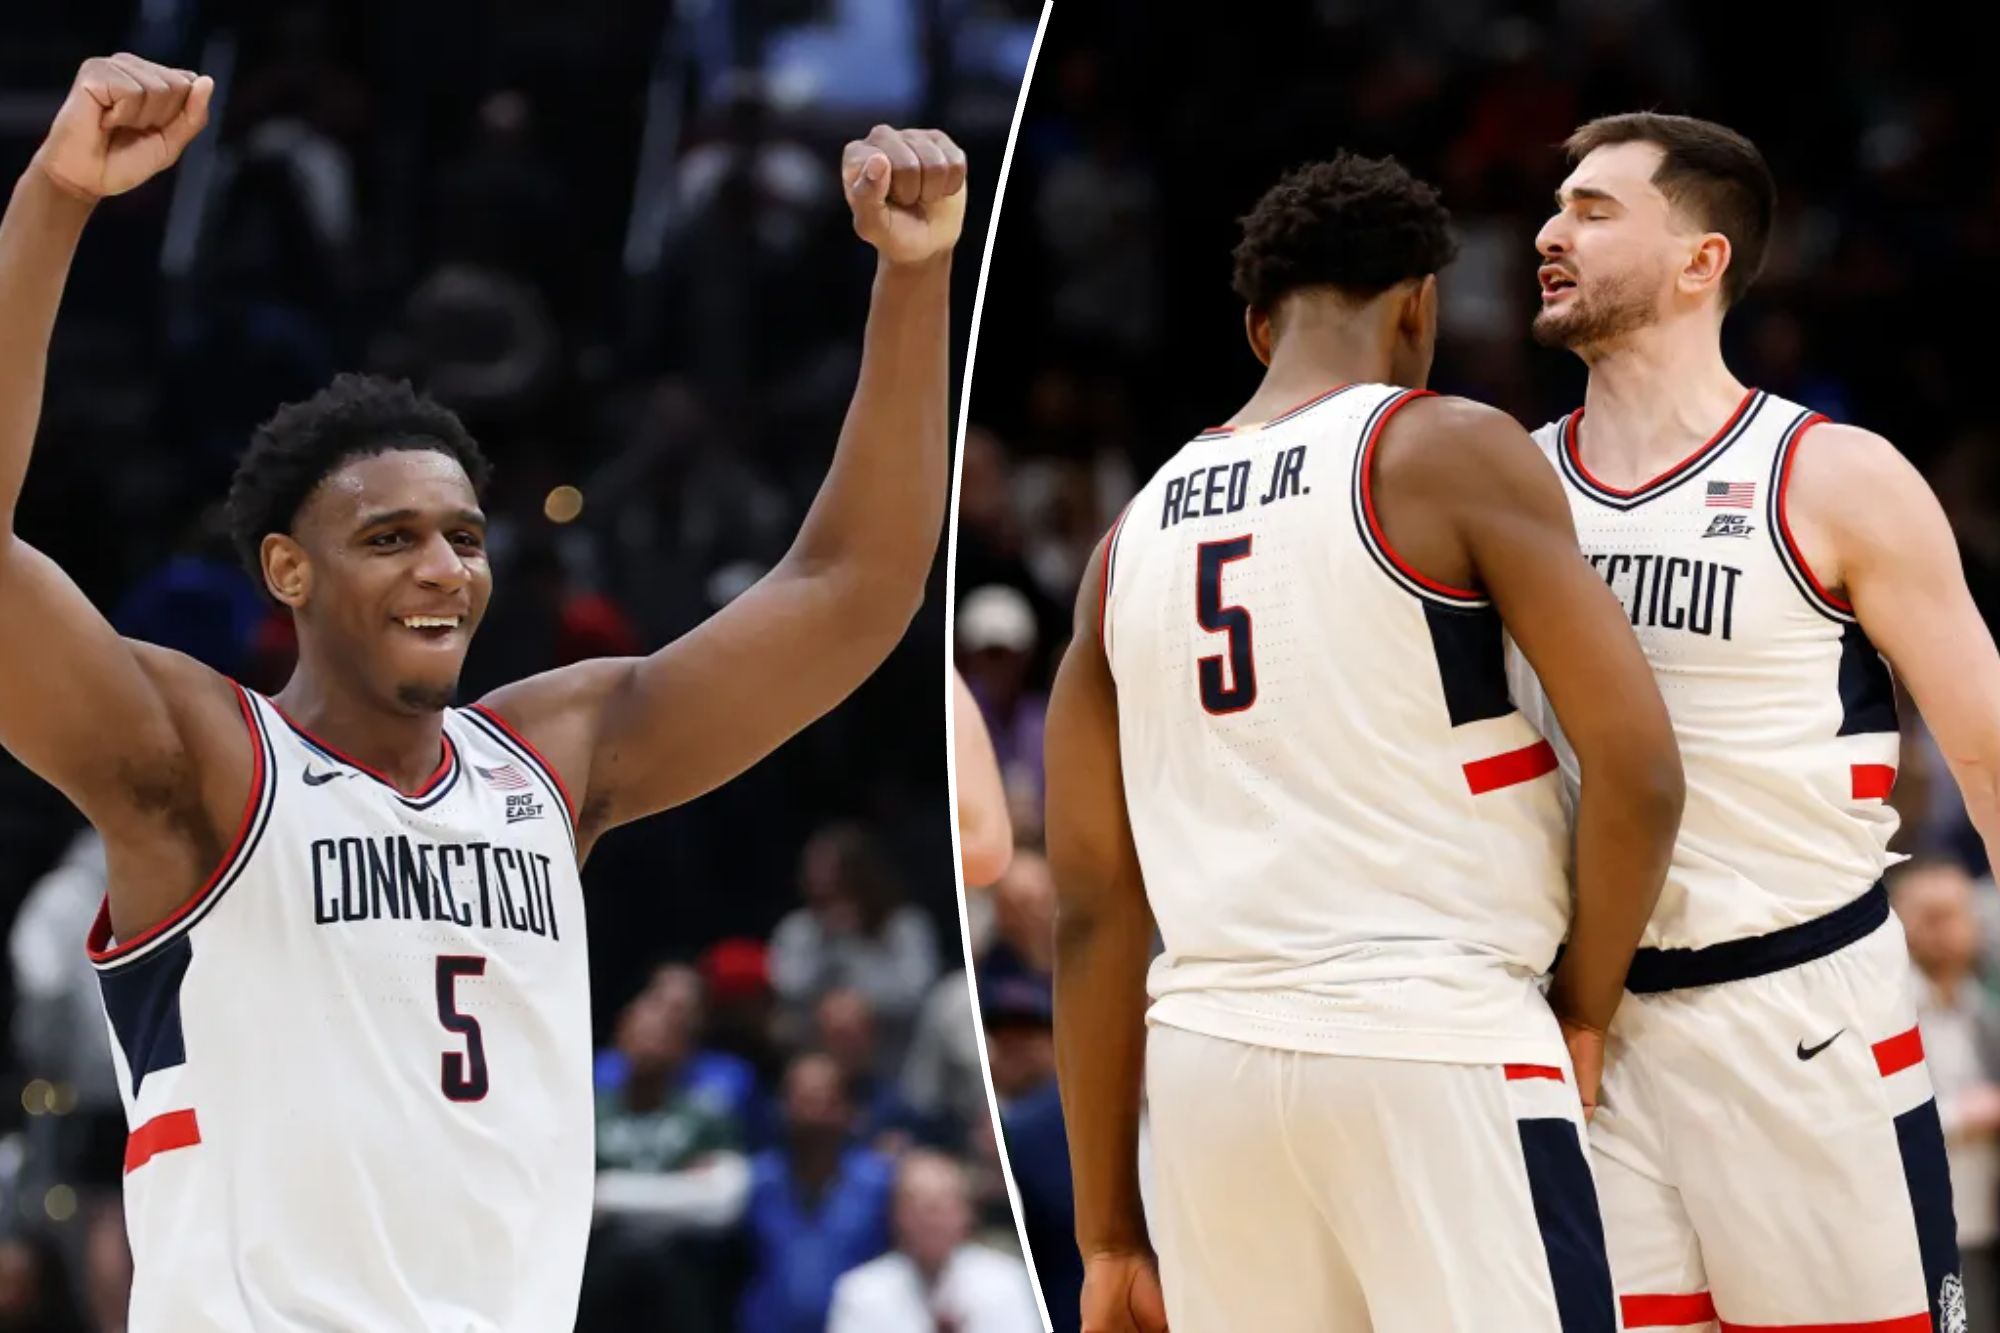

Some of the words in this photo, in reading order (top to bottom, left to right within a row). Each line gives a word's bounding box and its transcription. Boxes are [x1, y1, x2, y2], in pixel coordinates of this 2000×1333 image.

[1160, 460, 1252, 530] REED
[1260, 445, 1311, 506] JR.
[1709, 514, 1748, 524] BIG
[1195, 533, 1257, 716] 5
[1584, 554, 1743, 641] CTICUT
[506, 793, 534, 806] BIG
[506, 804, 544, 818] EAST
[435, 955, 489, 1103] 5
